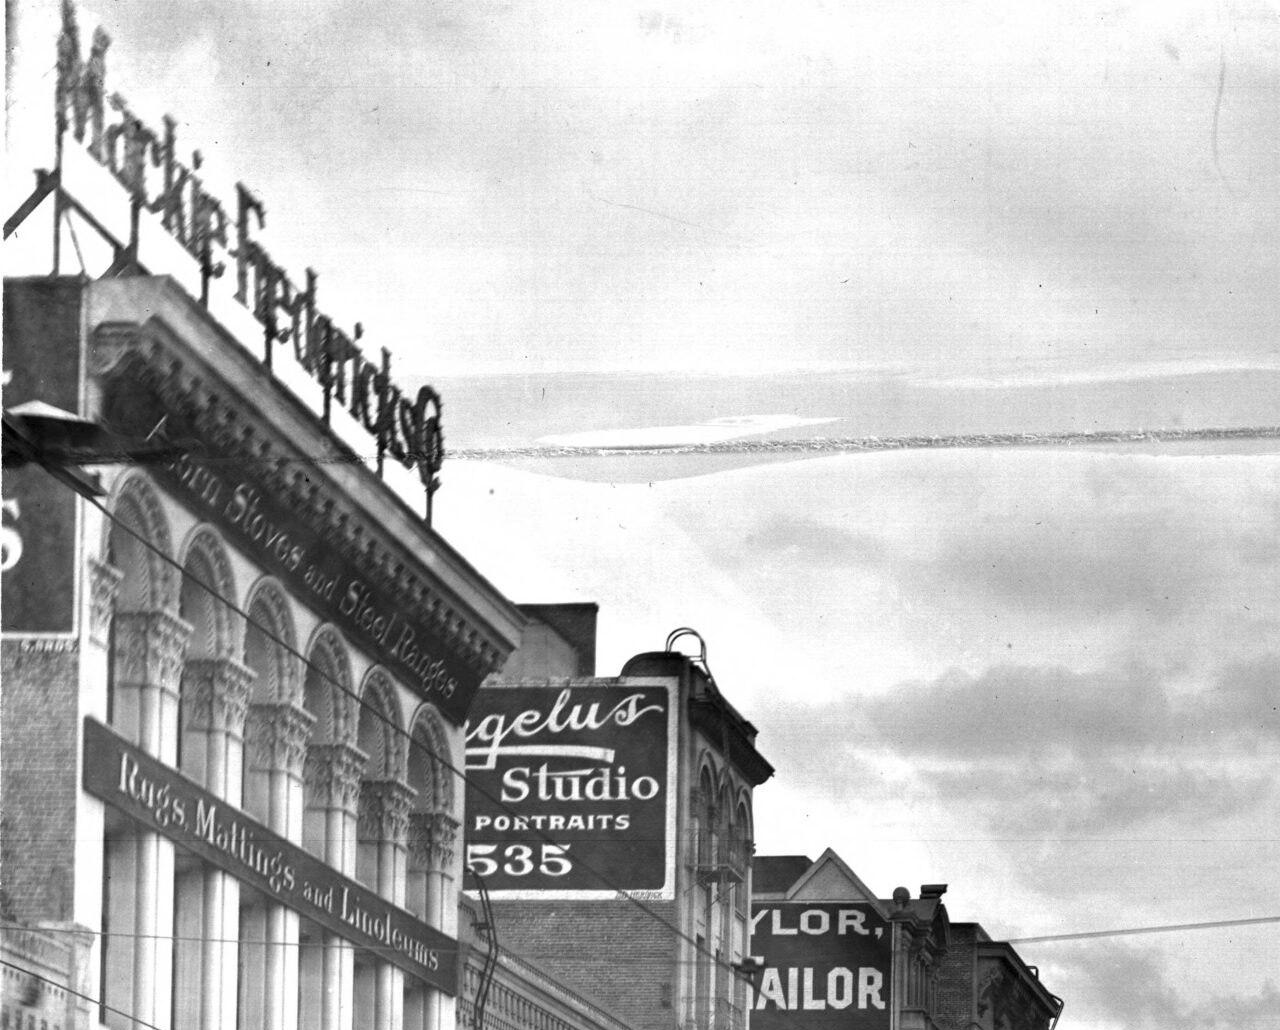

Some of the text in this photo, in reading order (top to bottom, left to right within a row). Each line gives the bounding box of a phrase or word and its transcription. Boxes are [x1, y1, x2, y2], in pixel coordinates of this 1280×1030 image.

[304, 564, 334, 611] and
[339, 580, 388, 648] Steel
[501, 763, 659, 802] Studio
[475, 815, 630, 831] PORTRAITS
[466, 843, 573, 876] 535
[195, 799, 296, 893] Mattings
[303, 881, 334, 913] and
[339, 886, 439, 972] Linoleums
